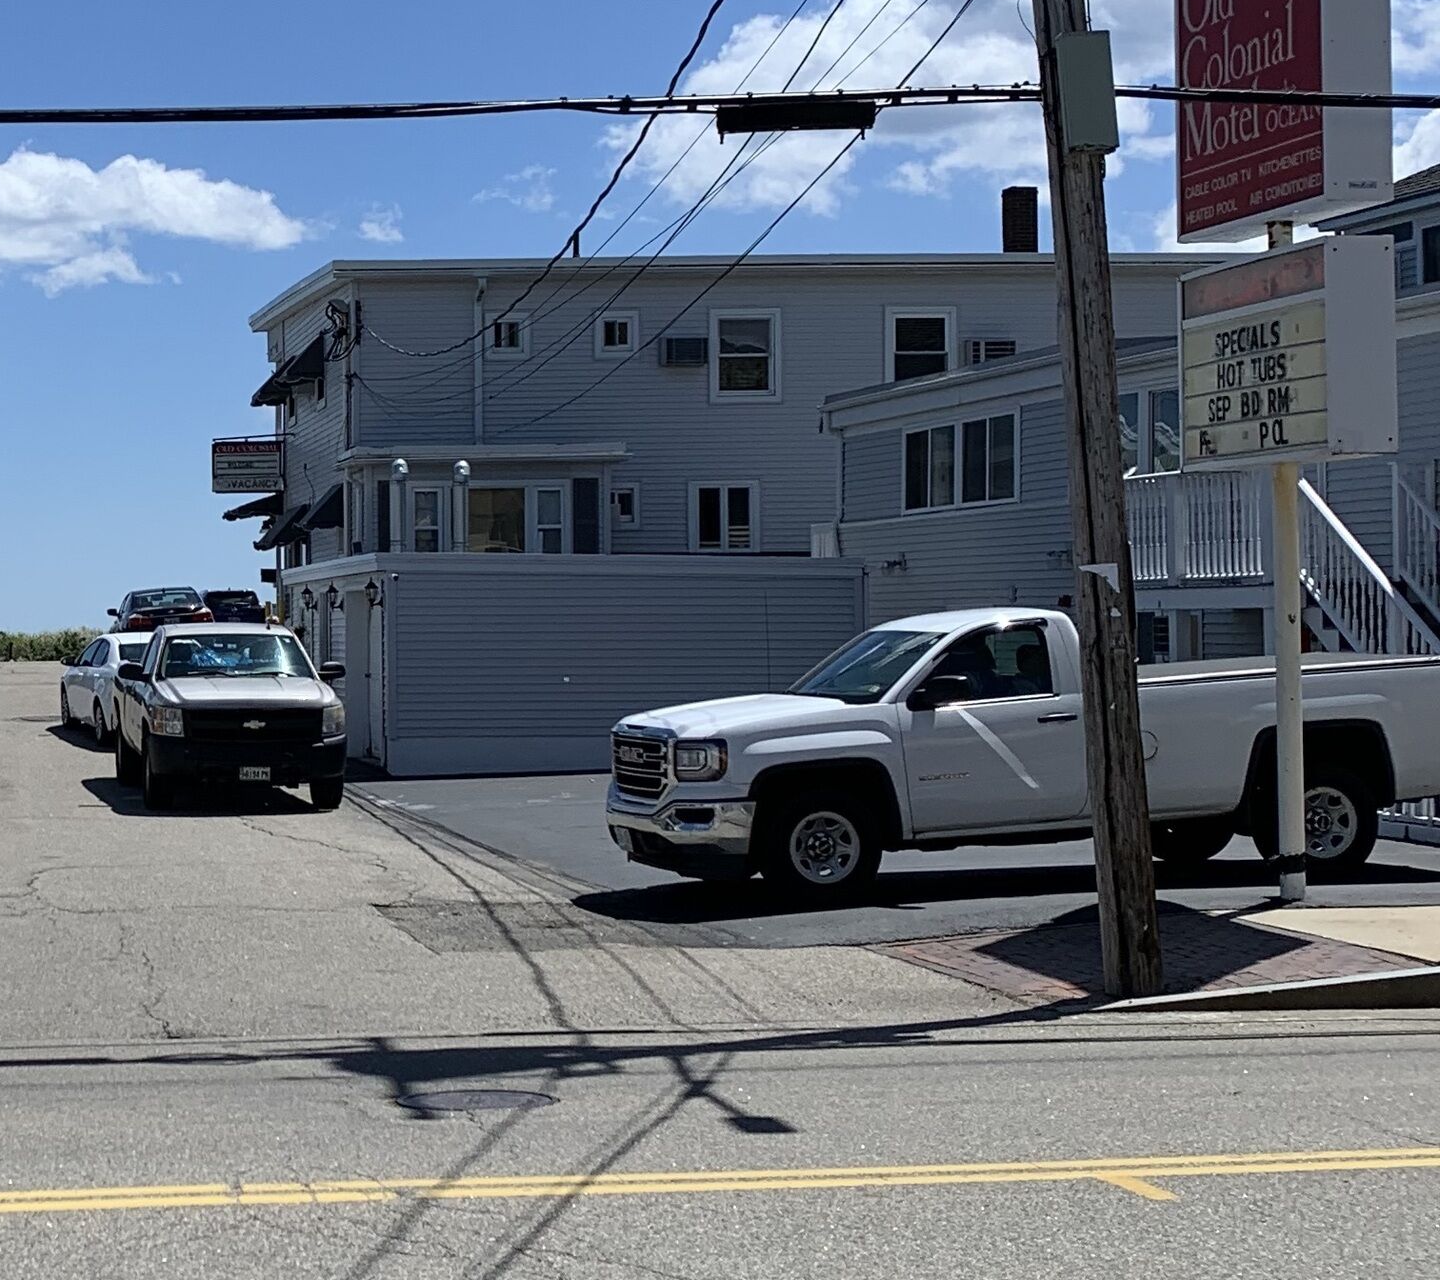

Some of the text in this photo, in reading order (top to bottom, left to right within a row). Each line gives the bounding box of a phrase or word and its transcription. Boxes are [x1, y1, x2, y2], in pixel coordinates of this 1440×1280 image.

[1184, 77, 1321, 162] Motel OCEAN
[1184, 146, 1322, 200] CABLE COLOR TV KITCHENETTES
[1185, 173, 1322, 225] HEATED POOL AIR CONDITIONED
[1215, 321, 1281, 358] SPECIALS
[1216, 353, 1288, 390] HOT TUBS
[1208, 385, 1291, 423] SEP BD RM
[216, 444, 234, 453] OLD
[231, 480, 278, 488] VACANCY
